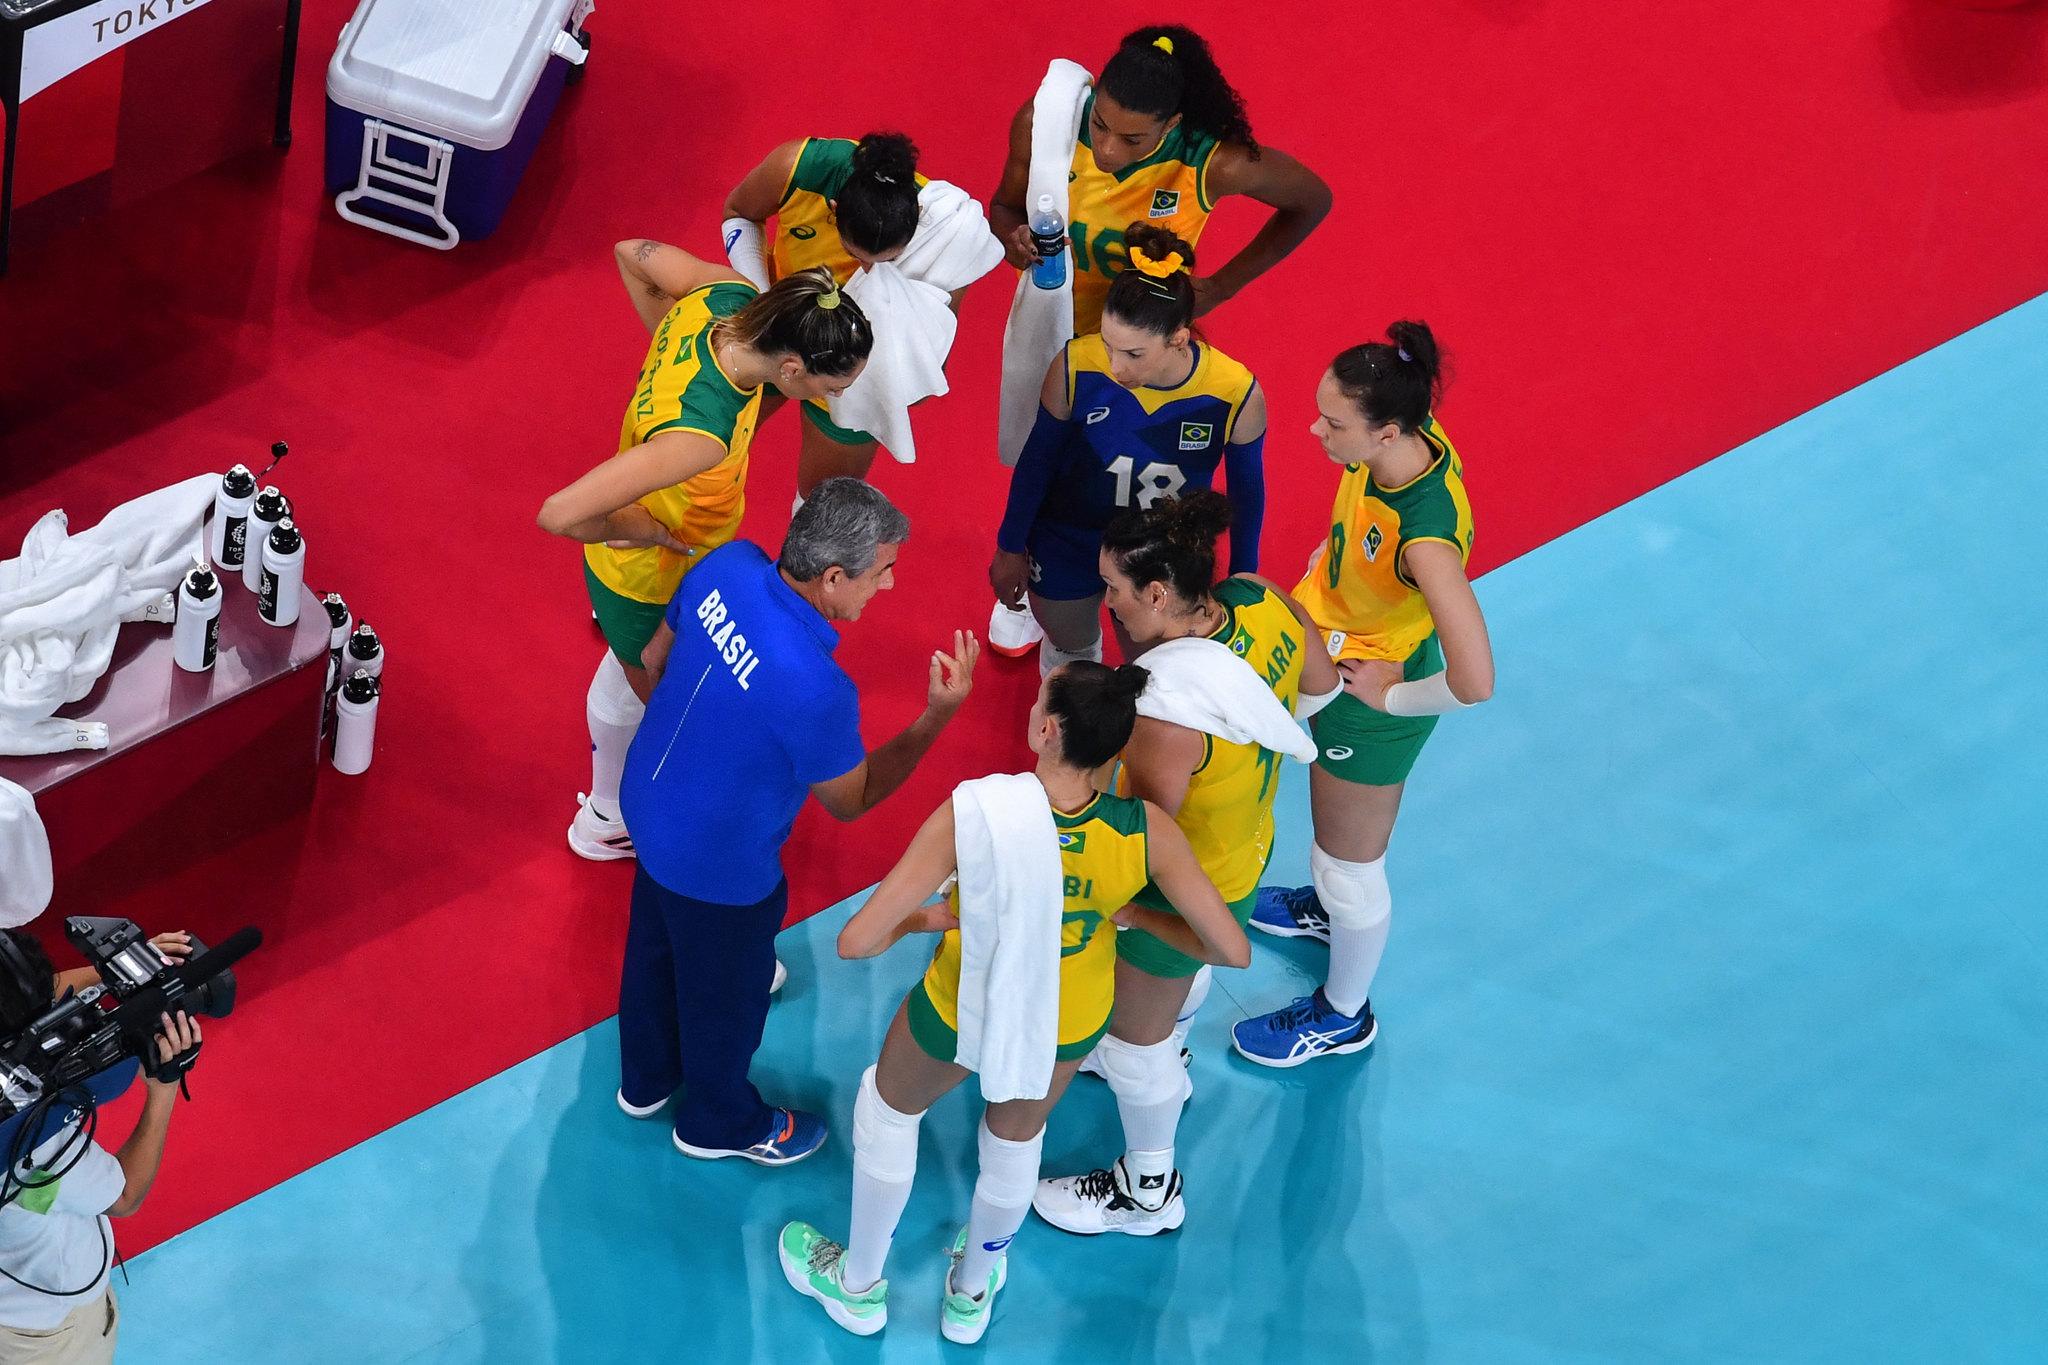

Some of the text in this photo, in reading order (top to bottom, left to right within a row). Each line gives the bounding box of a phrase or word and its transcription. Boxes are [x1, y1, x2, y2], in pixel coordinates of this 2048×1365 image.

[92, 0, 196, 43] TOKY
[1105, 454, 1188, 512] 18
[697, 588, 760, 691] BRASIL
[1063, 875, 1093, 899] BI
